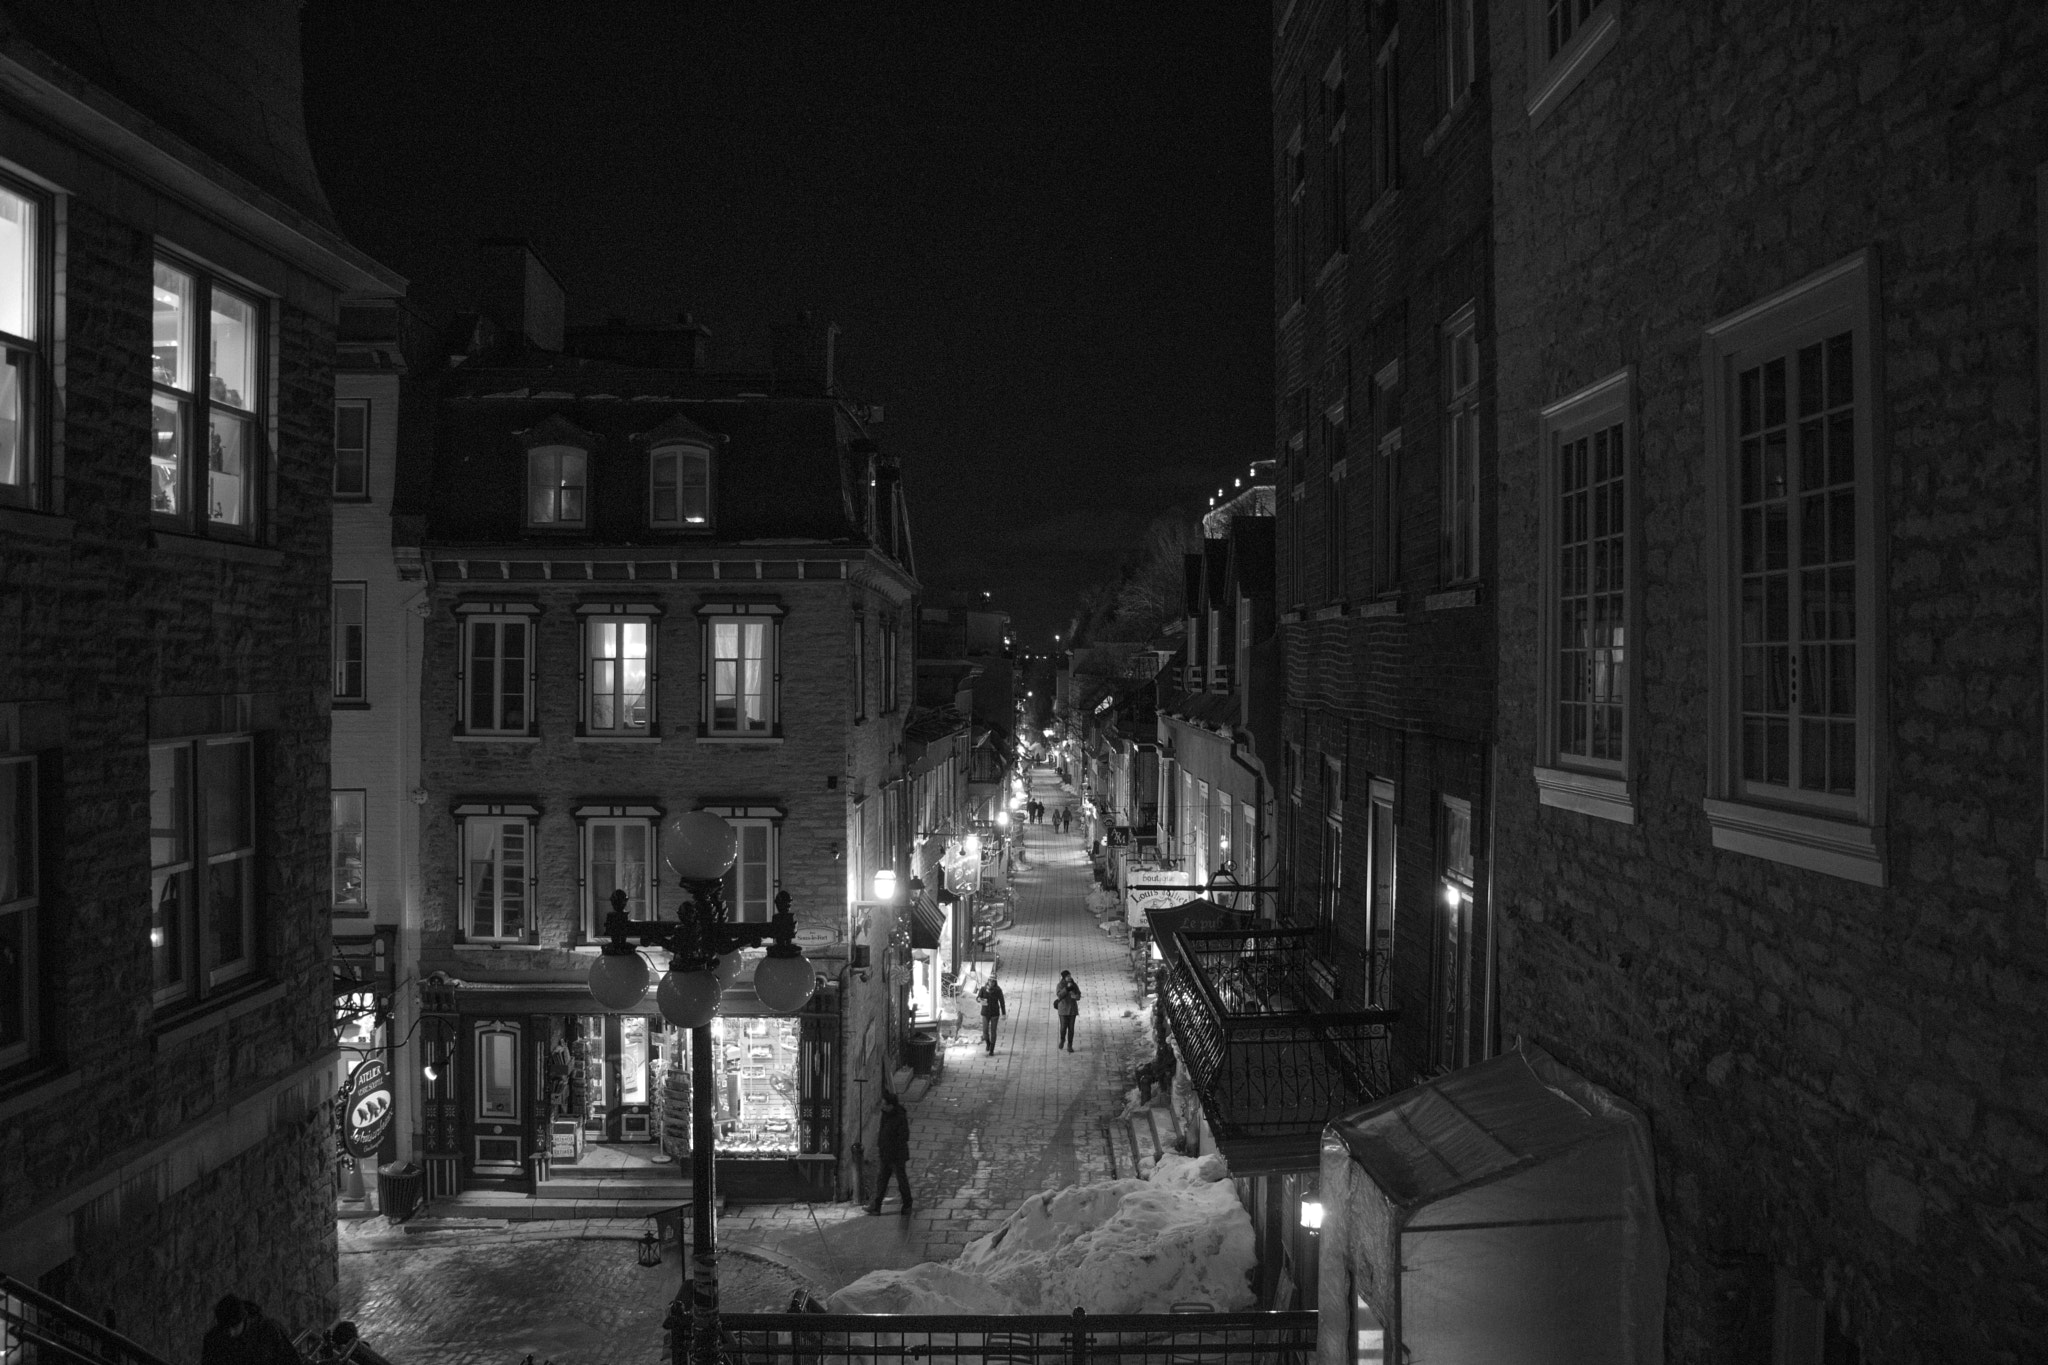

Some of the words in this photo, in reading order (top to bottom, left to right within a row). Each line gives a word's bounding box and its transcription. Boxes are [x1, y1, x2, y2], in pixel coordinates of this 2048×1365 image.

[1131, 890, 1159, 904] Louis
[1179, 917, 1196, 929] Le
[1200, 915, 1224, 932] pub
[358, 1065, 382, 1086] ATELIER
